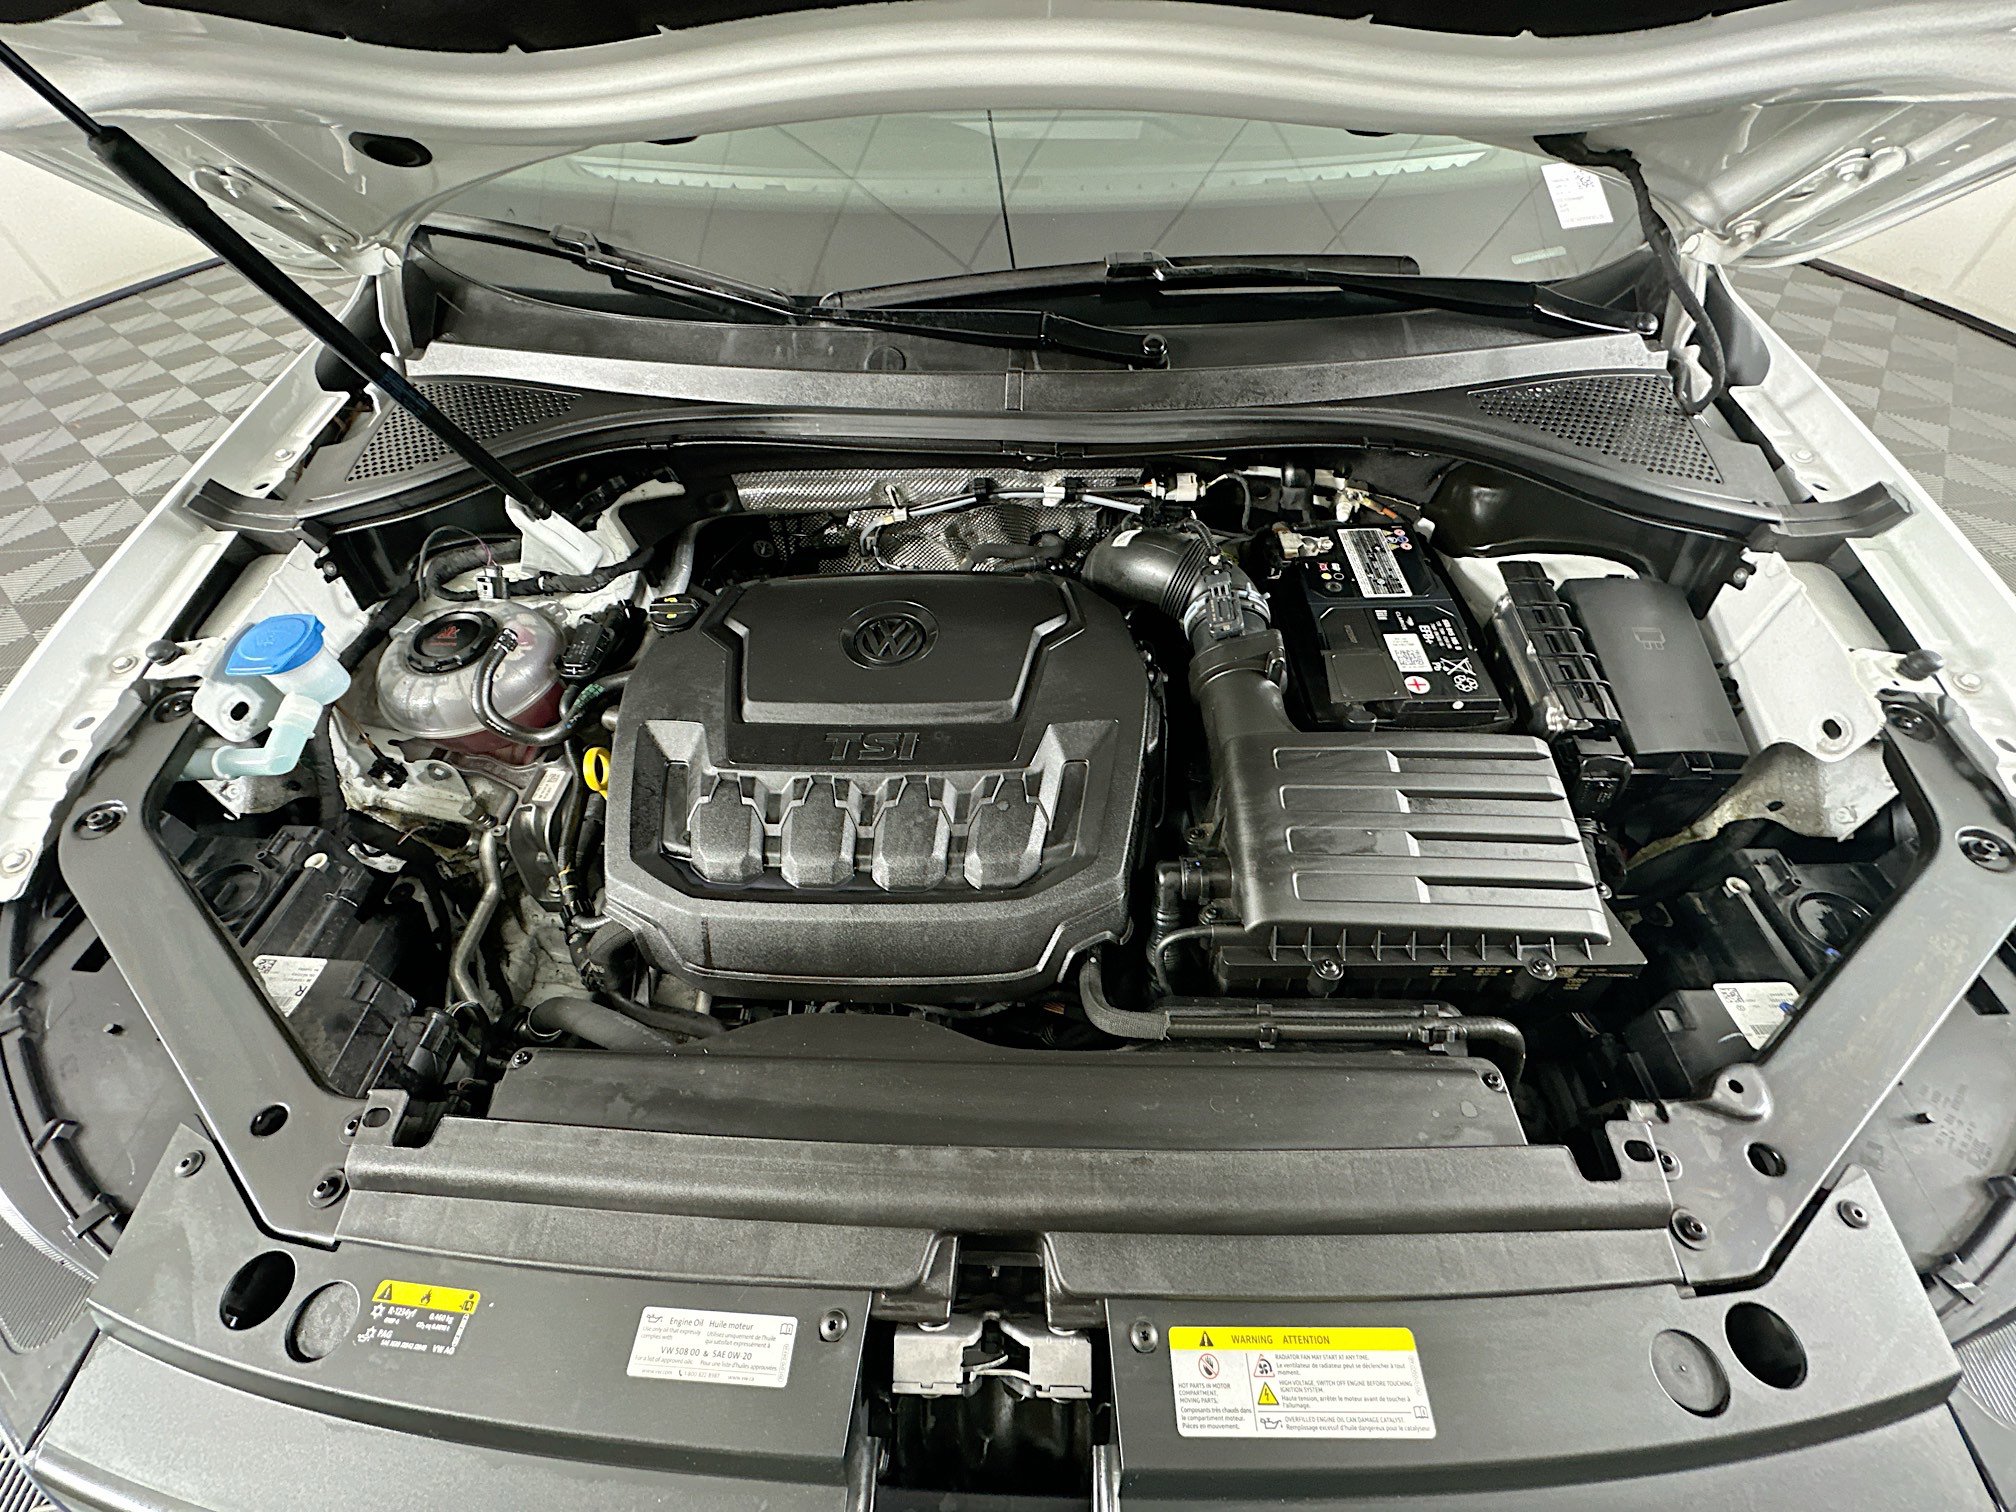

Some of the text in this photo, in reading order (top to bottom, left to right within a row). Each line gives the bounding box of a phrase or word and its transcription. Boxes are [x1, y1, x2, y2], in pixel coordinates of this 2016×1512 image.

[1418, 624, 1434, 644] EFB+
[1432, 662, 1442, 672] Pb
[825, 732, 919, 761] TSI
[388, 1306, 418, 1320] R-1234yf
[670, 1317, 692, 1327] Engine
[709, 1320, 727, 1328] Huile
[377, 1328, 394, 1339] PAG
[1231, 1335, 1330, 1345] WARNING ATTENTION
[432, 1344, 445, 1353] VW
[444, 1346, 455, 1355] AG
[661, 1346, 674, 1354] VW
[712, 1350, 726, 1358] SAE
[728, 1351, 752, 1360] 0W-20
